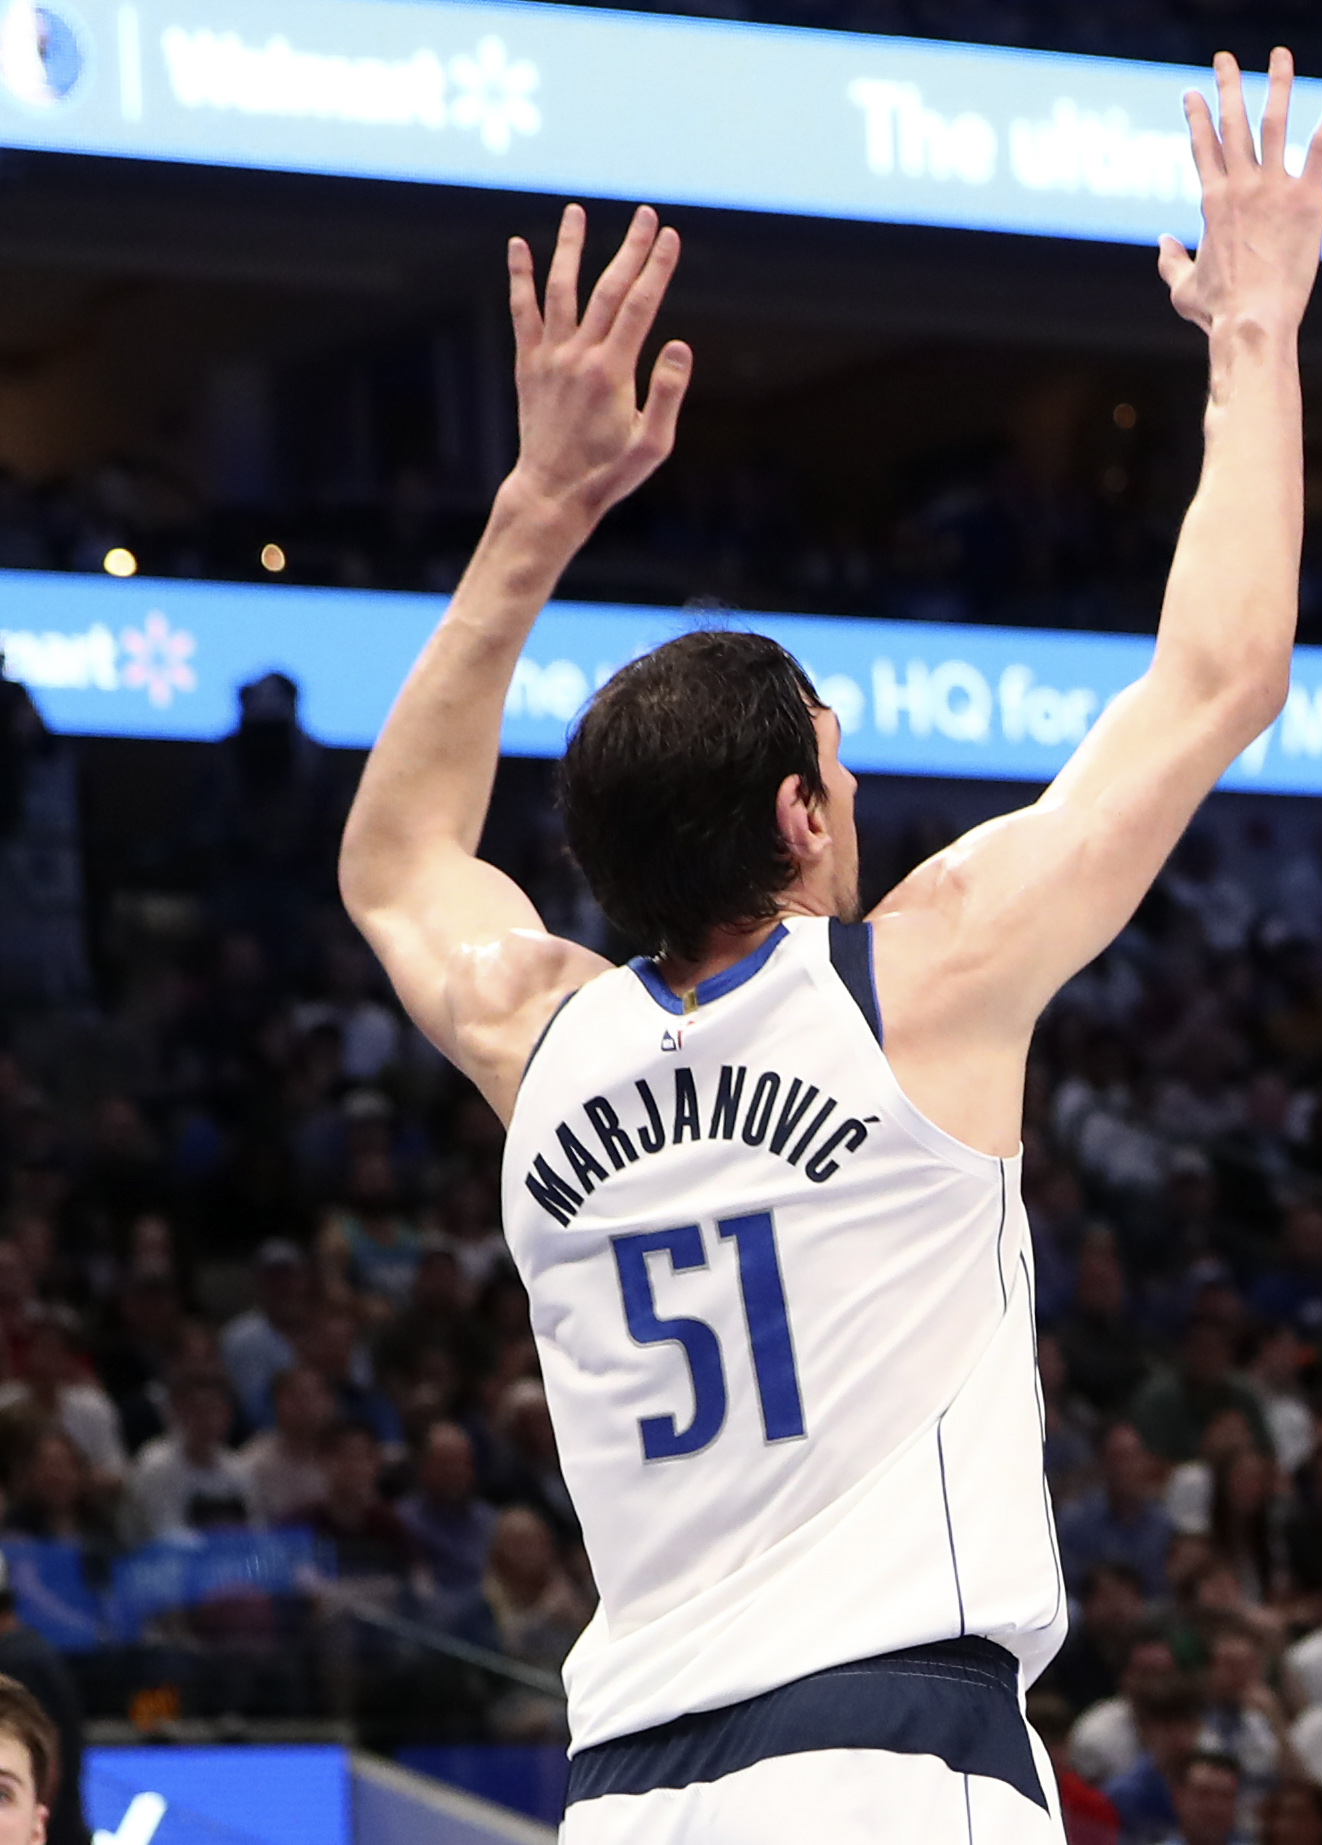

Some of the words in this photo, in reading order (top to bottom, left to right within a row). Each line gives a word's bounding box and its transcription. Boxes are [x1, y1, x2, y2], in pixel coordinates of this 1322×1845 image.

[162, 26, 446, 130] Walmart
[848, 77, 996, 183] The
[871, 656, 993, 745] HQ
[525, 1065, 880, 1228] MARJANOVIĆ
[608, 1207, 808, 1465] 51
